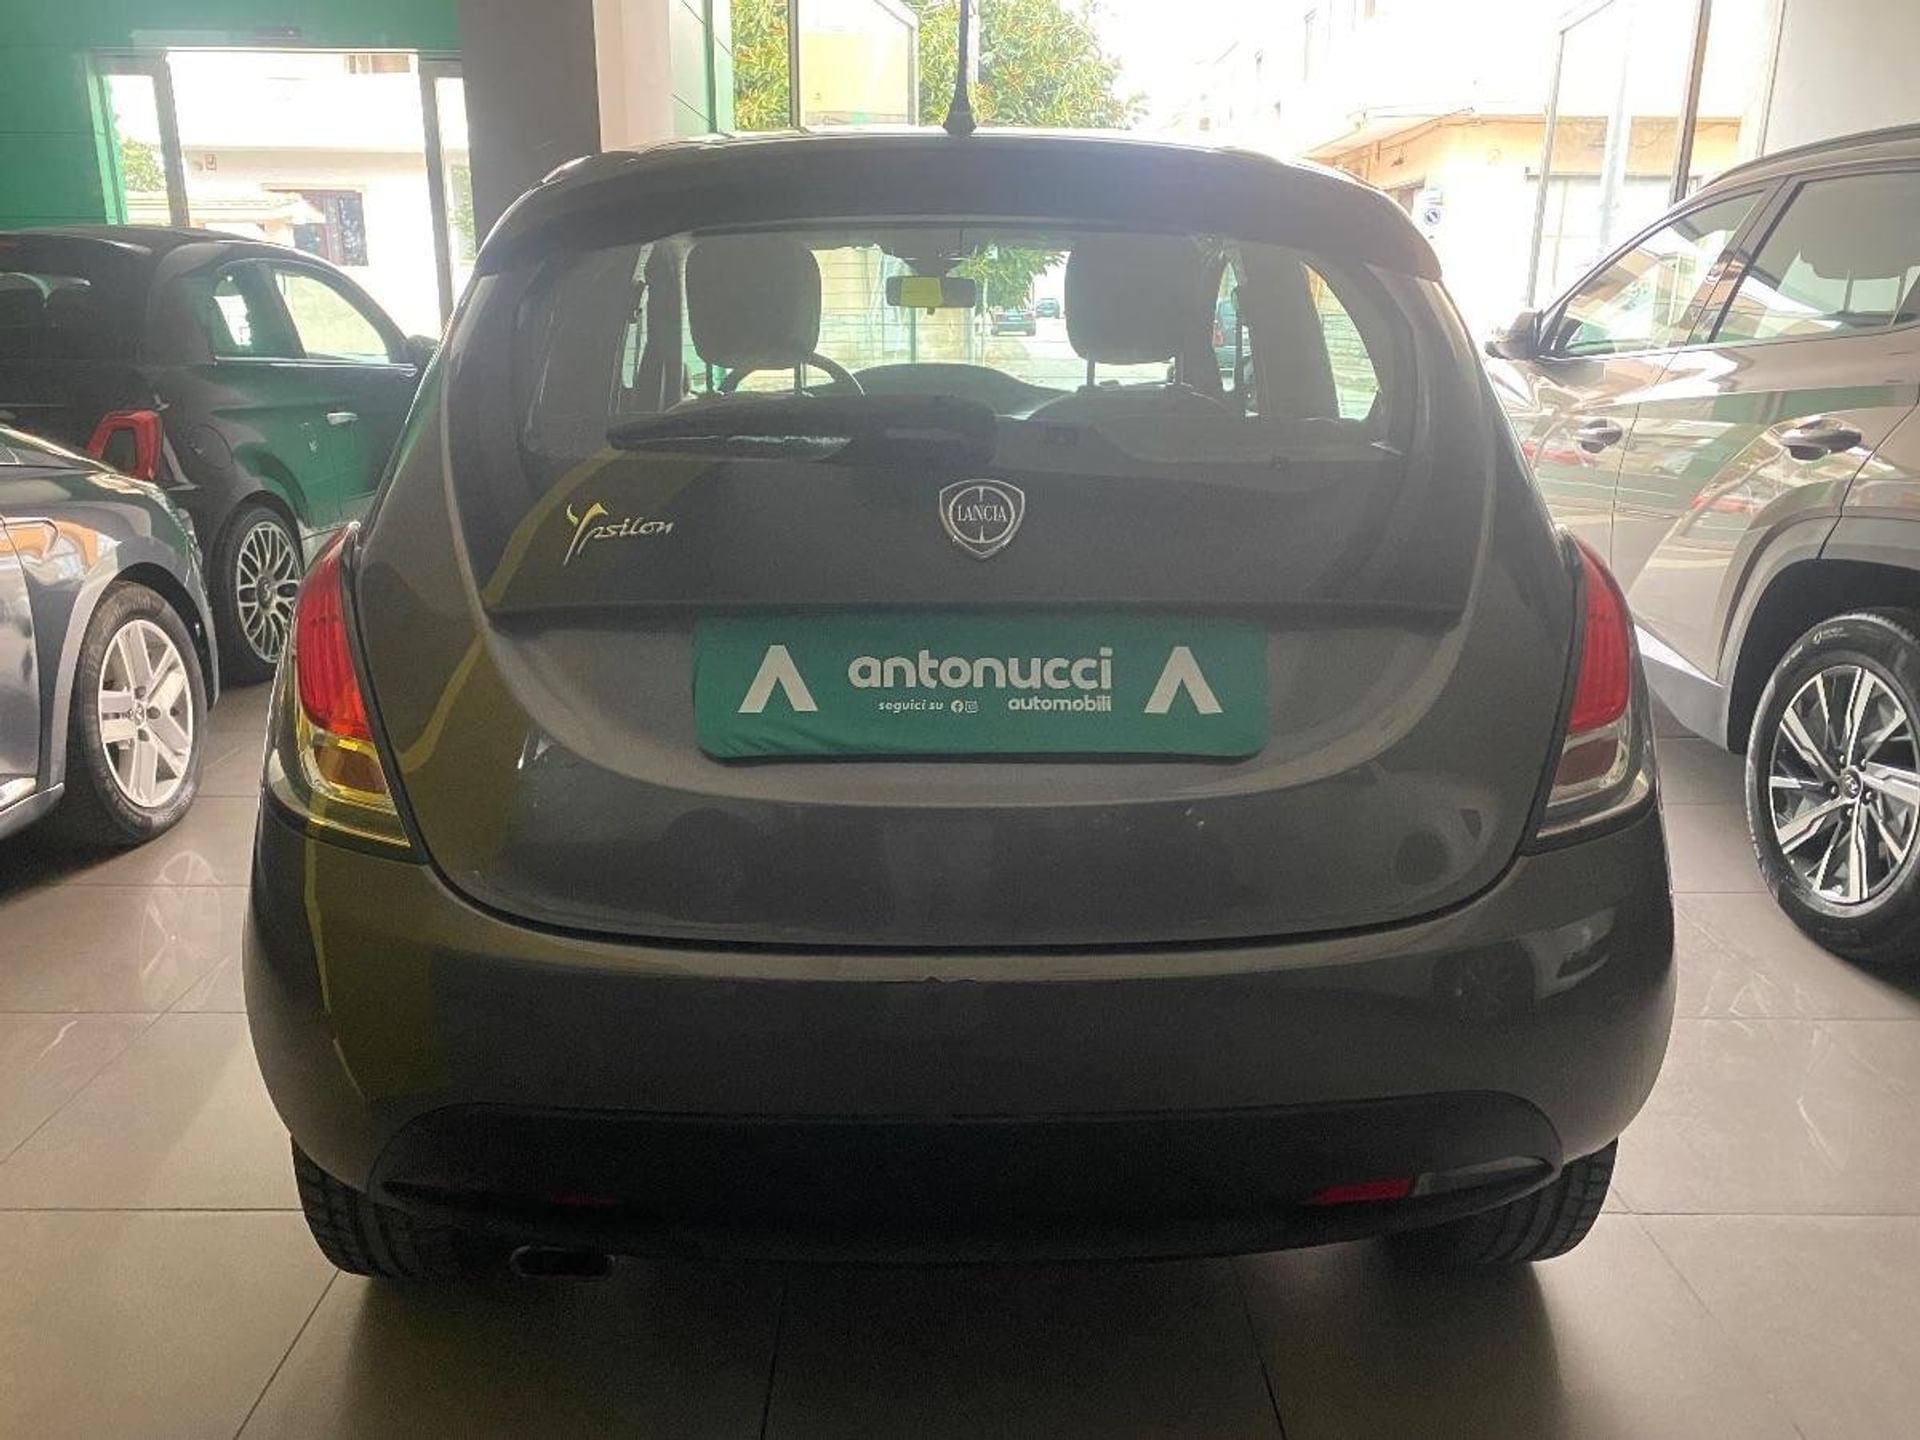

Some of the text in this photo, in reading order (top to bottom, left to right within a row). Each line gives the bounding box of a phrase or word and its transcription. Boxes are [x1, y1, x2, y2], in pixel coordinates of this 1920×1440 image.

[958, 504, 1007, 522] LANCIA
[563, 502, 675, 566] Ypsilon
[848, 647, 1114, 690] antonucci
[878, 698, 944, 714] seguici su
[1008, 695, 1112, 712] automobili
